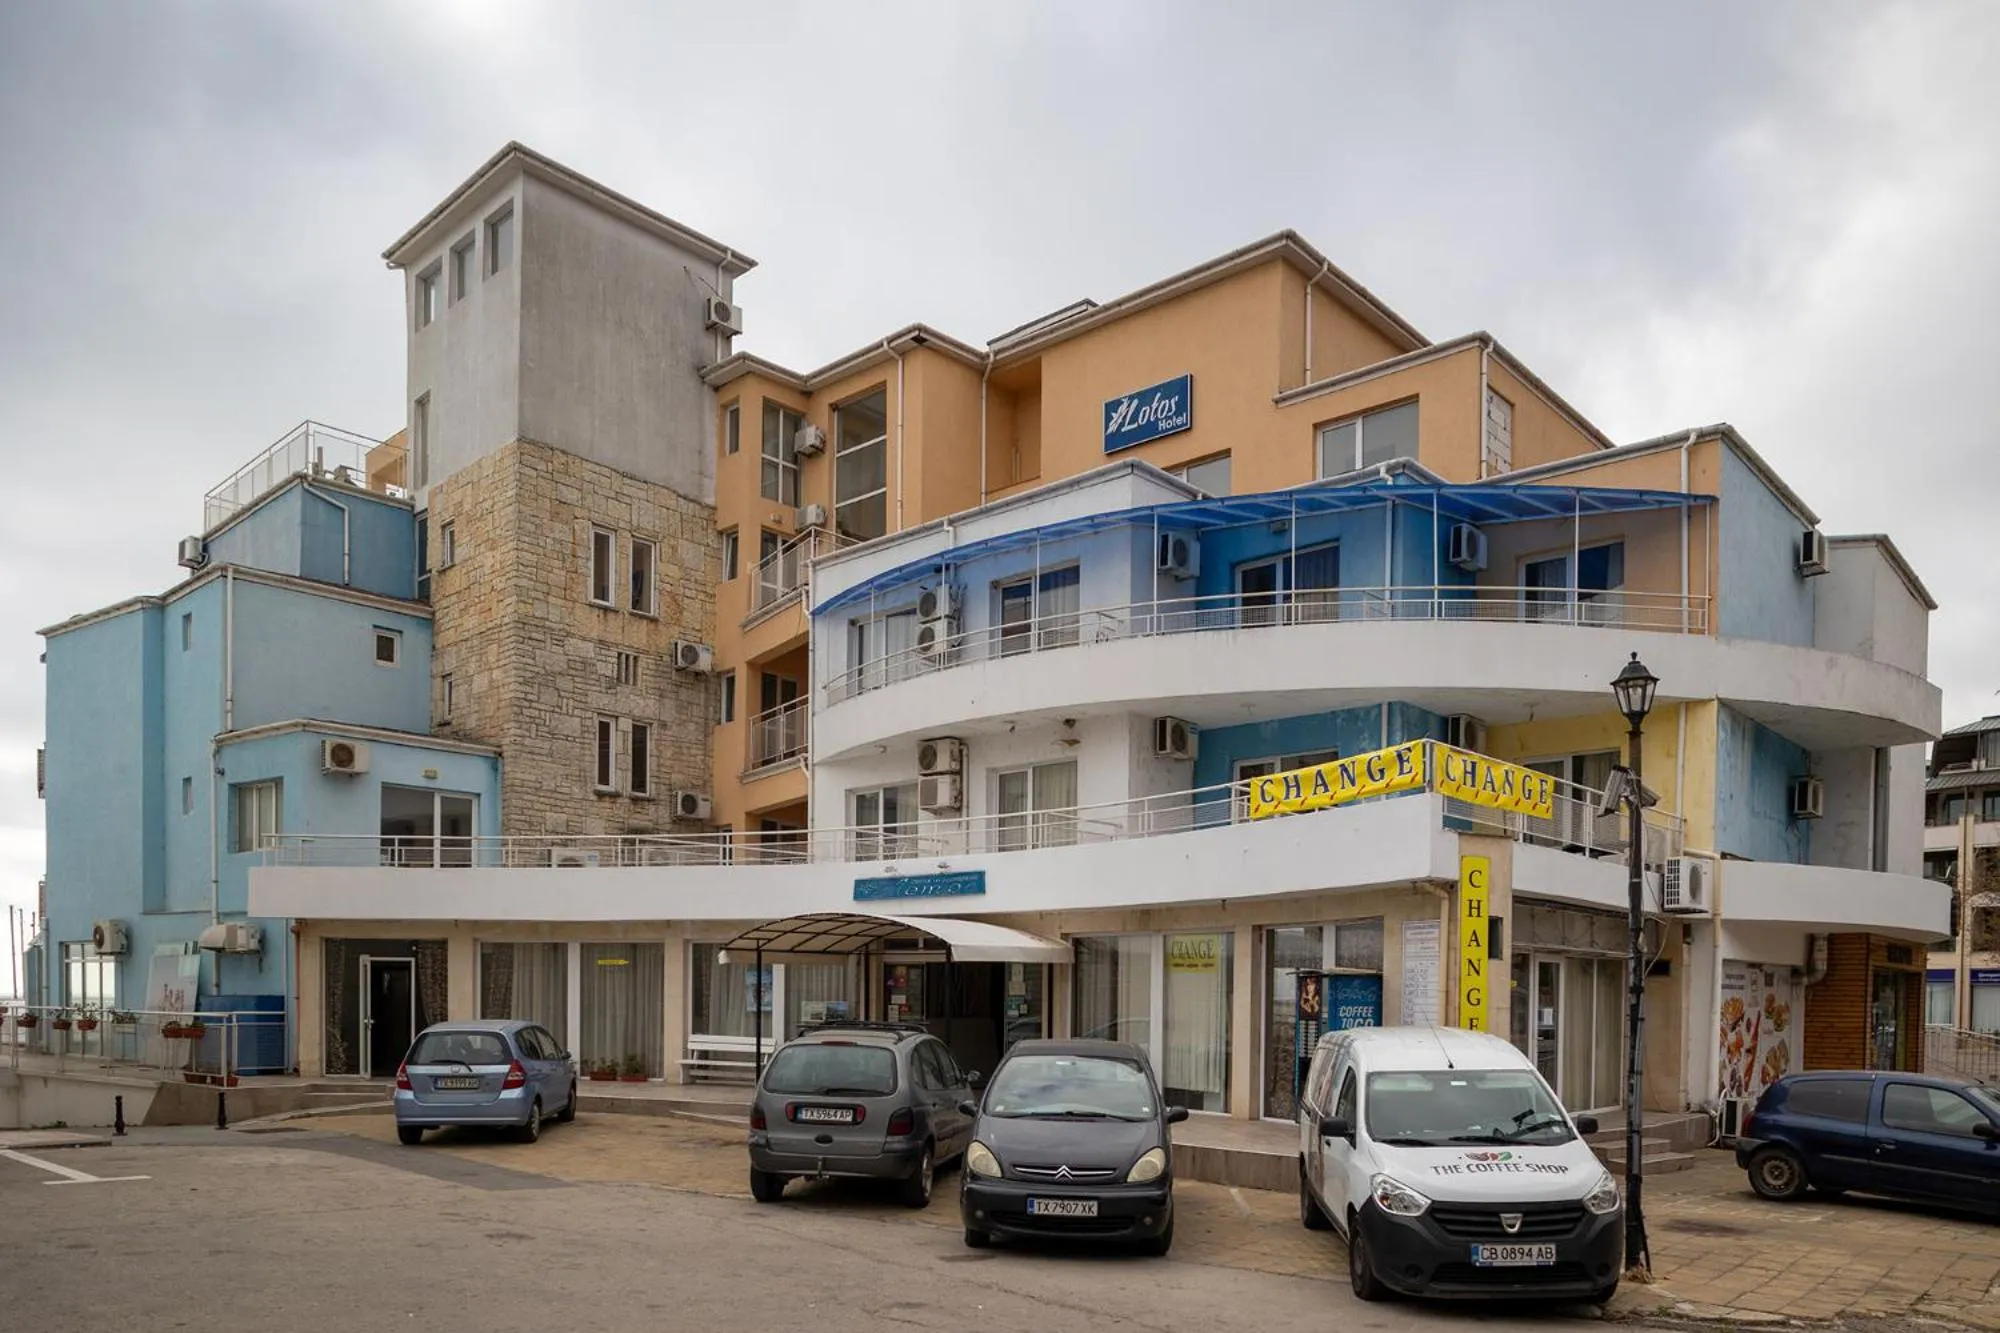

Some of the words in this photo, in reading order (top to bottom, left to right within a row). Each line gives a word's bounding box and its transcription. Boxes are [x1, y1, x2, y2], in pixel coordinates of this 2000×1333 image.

[1121, 392, 1179, 433] Lotos
[1158, 412, 1187, 431] Hotel
[1259, 746, 1414, 804] CHANGE
[1445, 753, 1549, 805] CHANGE
[1466, 869, 1483, 1031] CHANGE
[1339, 1005, 1374, 1018] COFFEE
[1430, 1165, 1465, 1176] THE
[1466, 1163, 1524, 1174] COFFEE
[1525, 1163, 1569, 1174] SHOP
[1052, 1202, 1079, 1214] 7907
[1481, 1247, 1498, 1260] CB
[1501, 1247, 1532, 1260] 0894
[1536, 1247, 1554, 1260] AB
